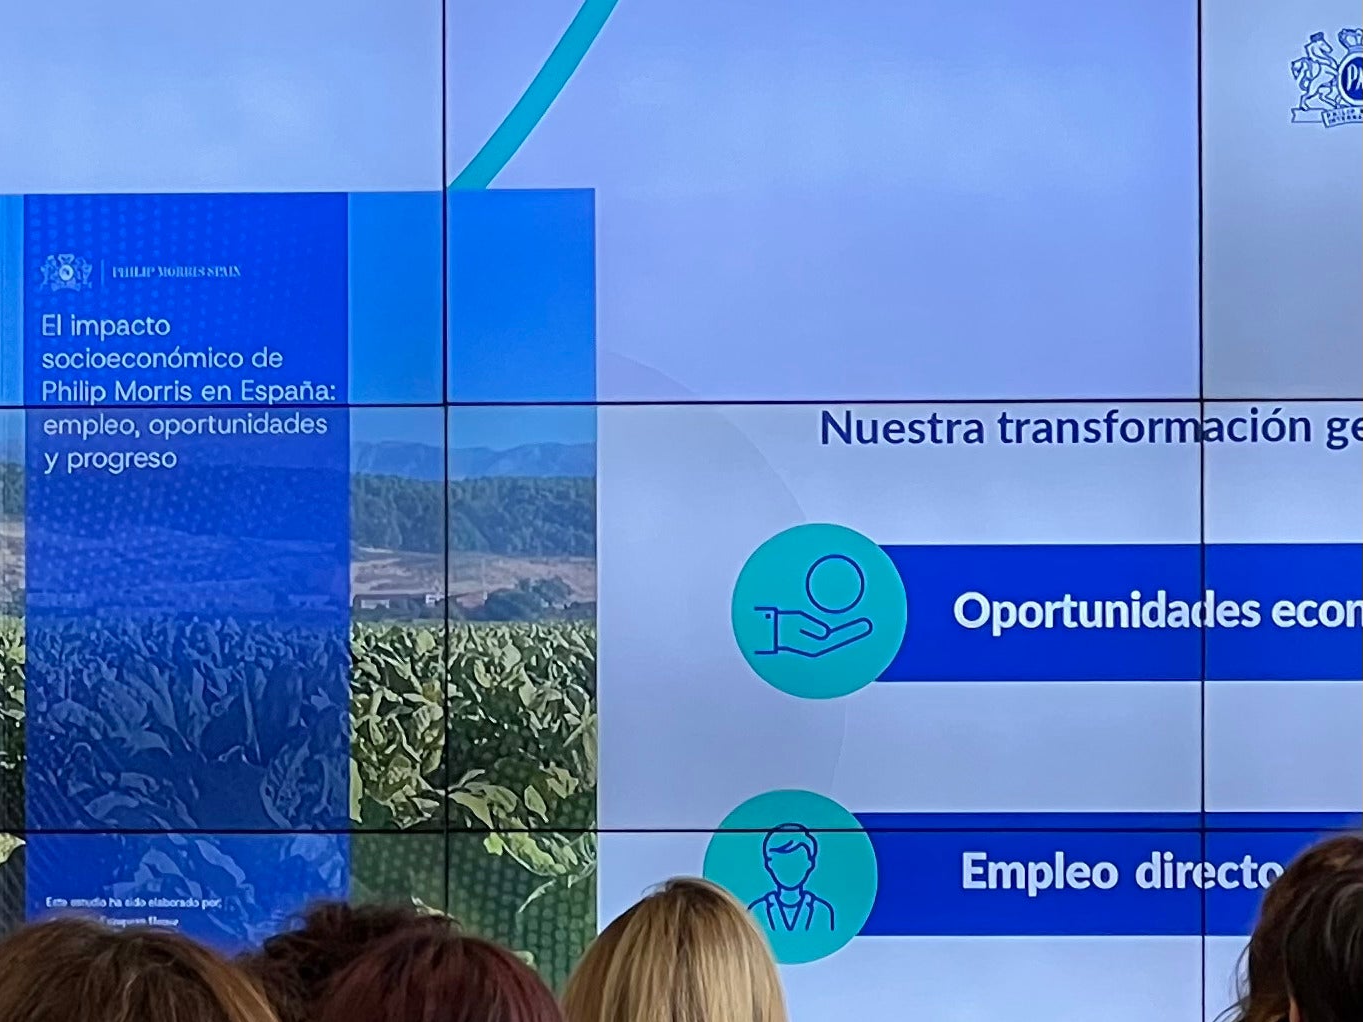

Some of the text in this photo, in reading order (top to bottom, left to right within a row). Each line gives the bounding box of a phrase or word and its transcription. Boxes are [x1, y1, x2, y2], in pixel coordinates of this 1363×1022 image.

[112, 266, 241, 278] PHILIP MORRIS SPAIN
[42, 314, 171, 341] El impacto
[42, 346, 283, 369] socioeconómico de
[42, 380, 336, 405] Philip Morris en España:
[43, 412, 327, 439] empleo, oportunidades
[821, 410, 985, 444] Nuestra
[997, 407, 1311, 444] transformación
[44, 450, 177, 474] y progreso
[953, 589, 1261, 636] Oportunidades
[962, 851, 1284, 897] Empleo directo
[108, 897, 123, 907] ha
[148, 897, 200, 907] elaborado
